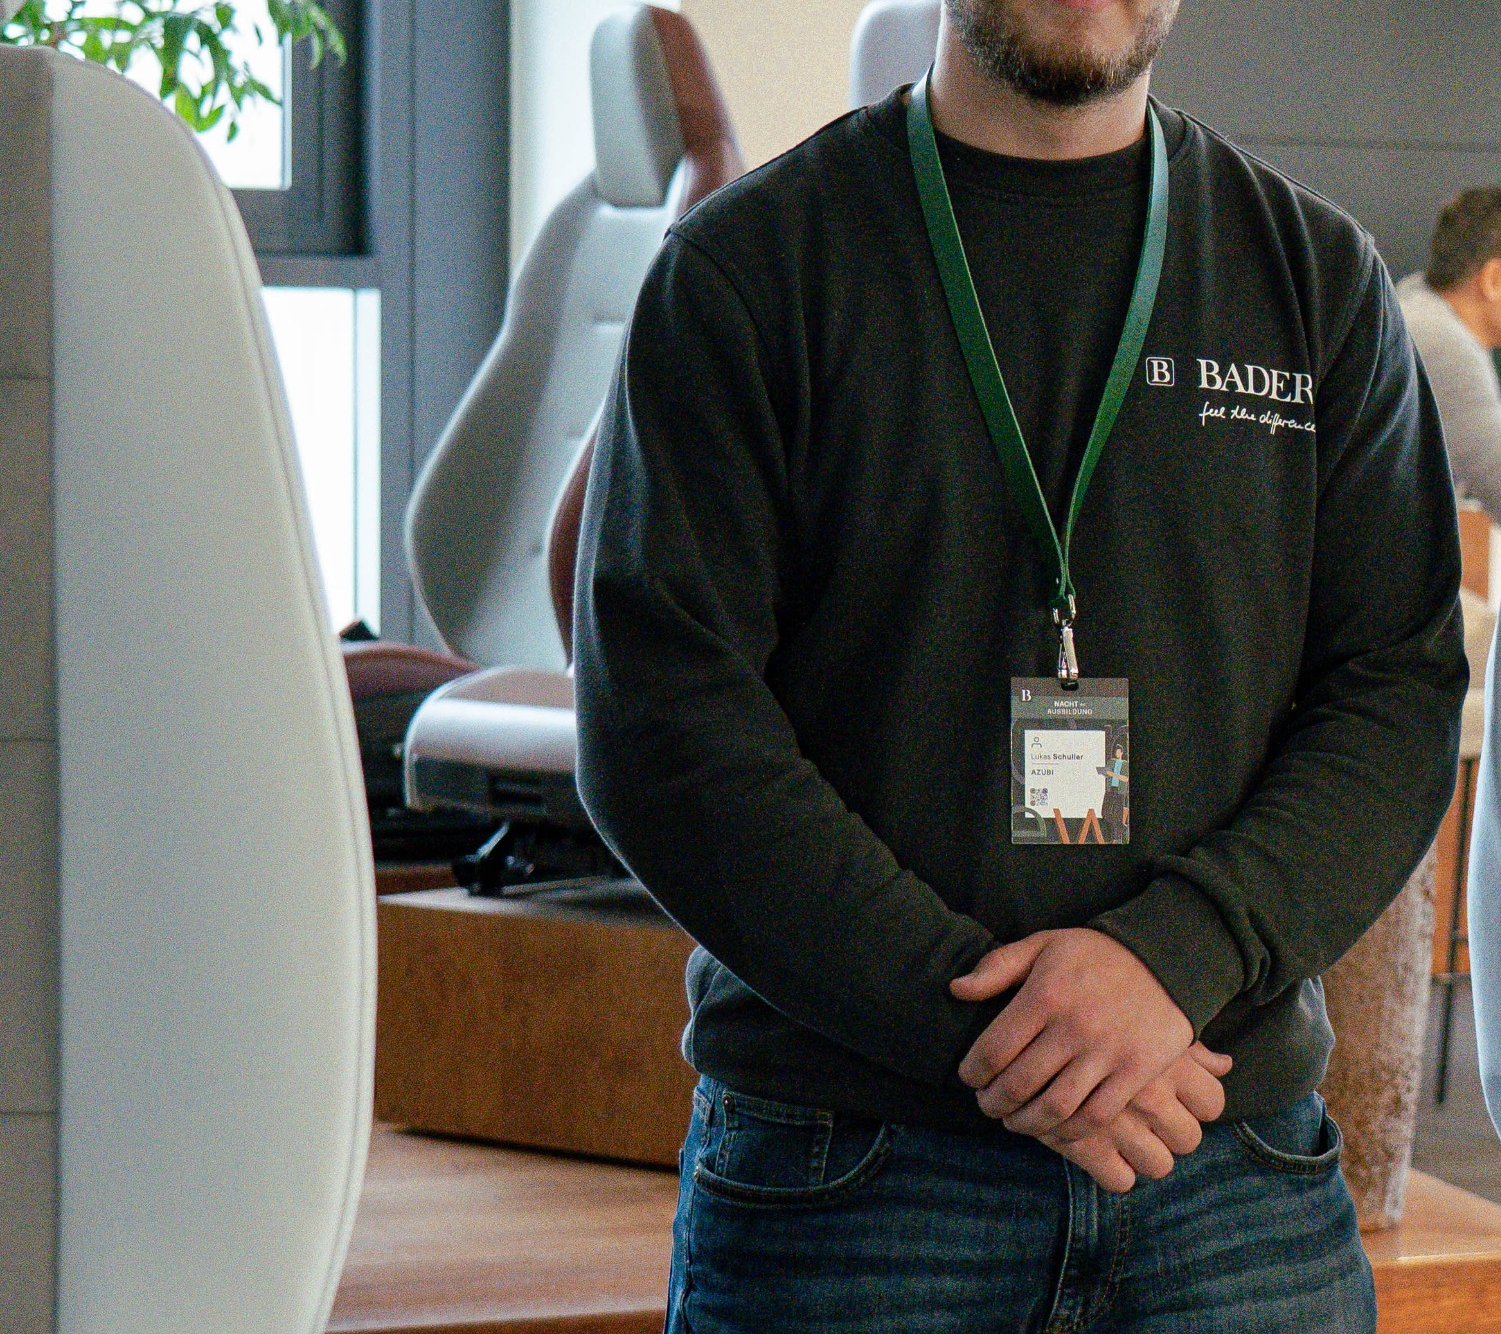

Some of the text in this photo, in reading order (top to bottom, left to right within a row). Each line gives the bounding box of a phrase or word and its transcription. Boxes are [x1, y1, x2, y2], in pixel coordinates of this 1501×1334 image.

[1151, 358, 1314, 405] B BADER
[1199, 401, 1226, 427] feel
[1259, 410, 1316, 435] difference
[1021, 689, 1032, 702] B
